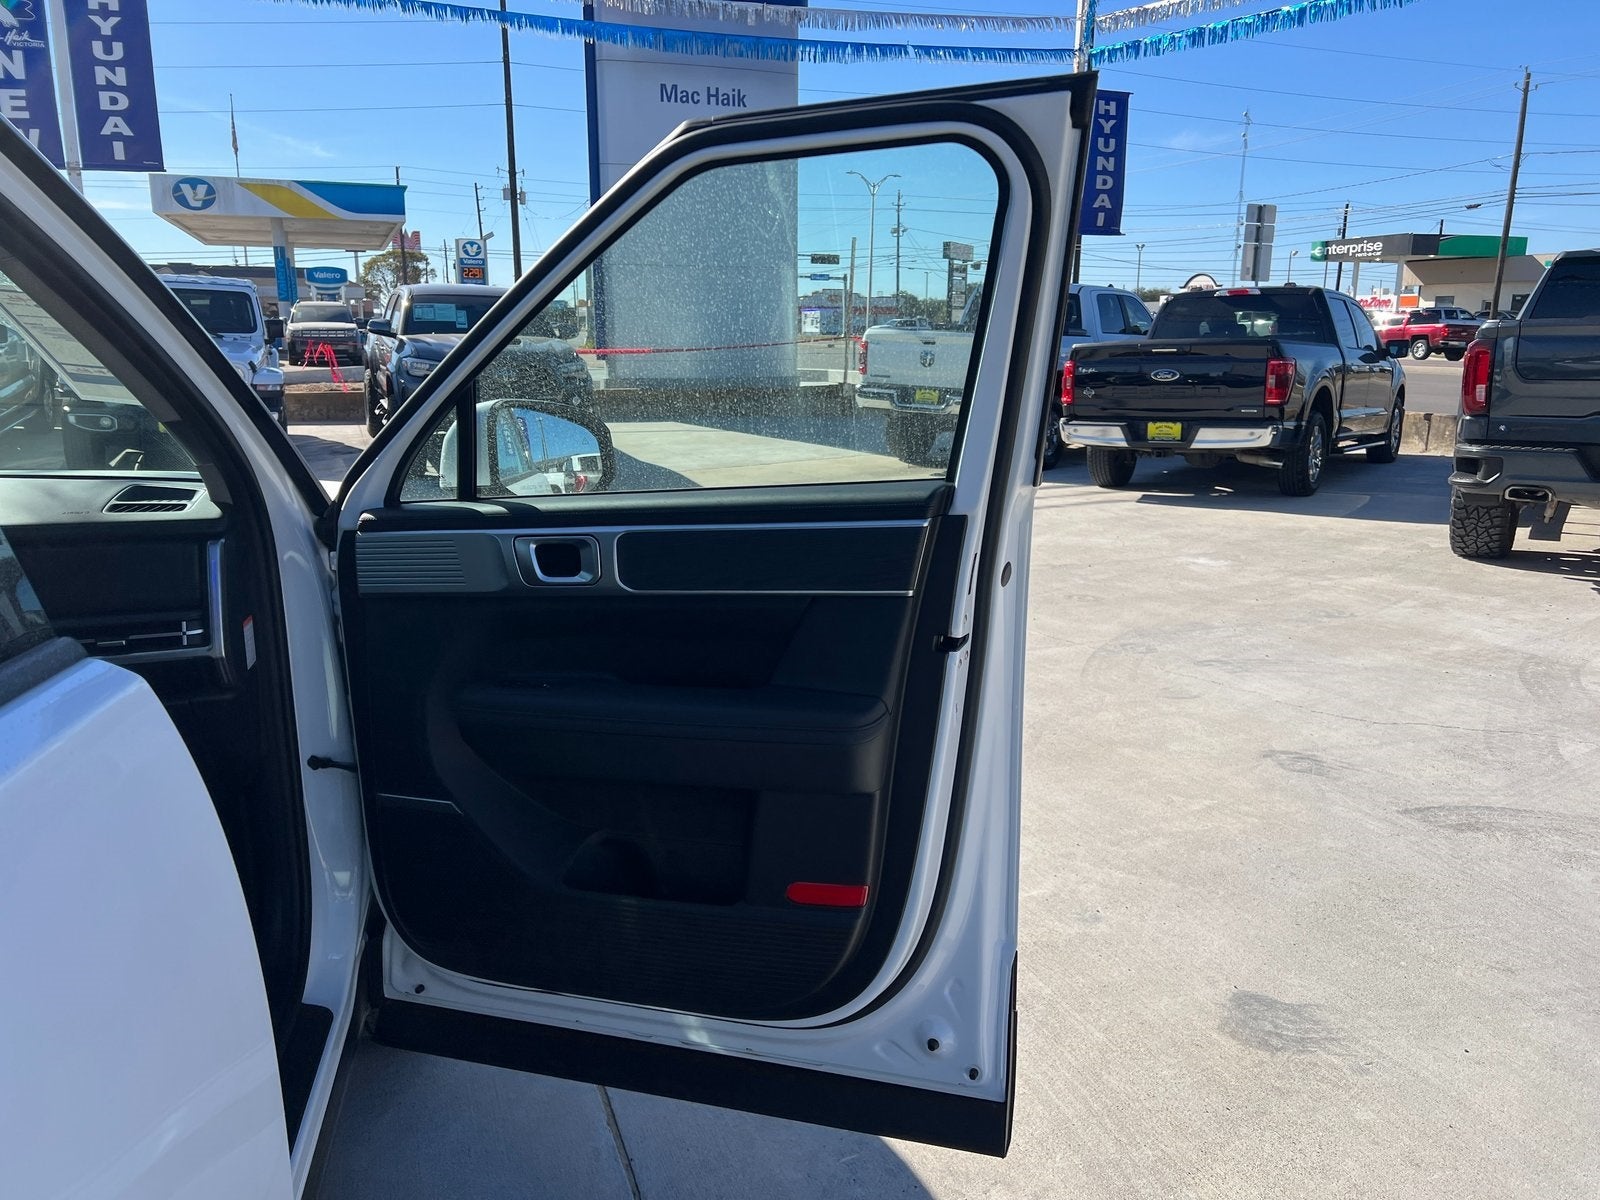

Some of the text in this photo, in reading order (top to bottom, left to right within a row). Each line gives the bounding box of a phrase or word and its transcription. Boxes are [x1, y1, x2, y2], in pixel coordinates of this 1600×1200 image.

[0, 50, 40, 148] NE
[87, 0, 134, 161] HYUNDAI
[660, 83, 747, 108] Mac Haik
[1092, 99, 1118, 227] HYUNDAI
[312, 271, 341, 279] Valero
[1311, 240, 1383, 257] enterprise
